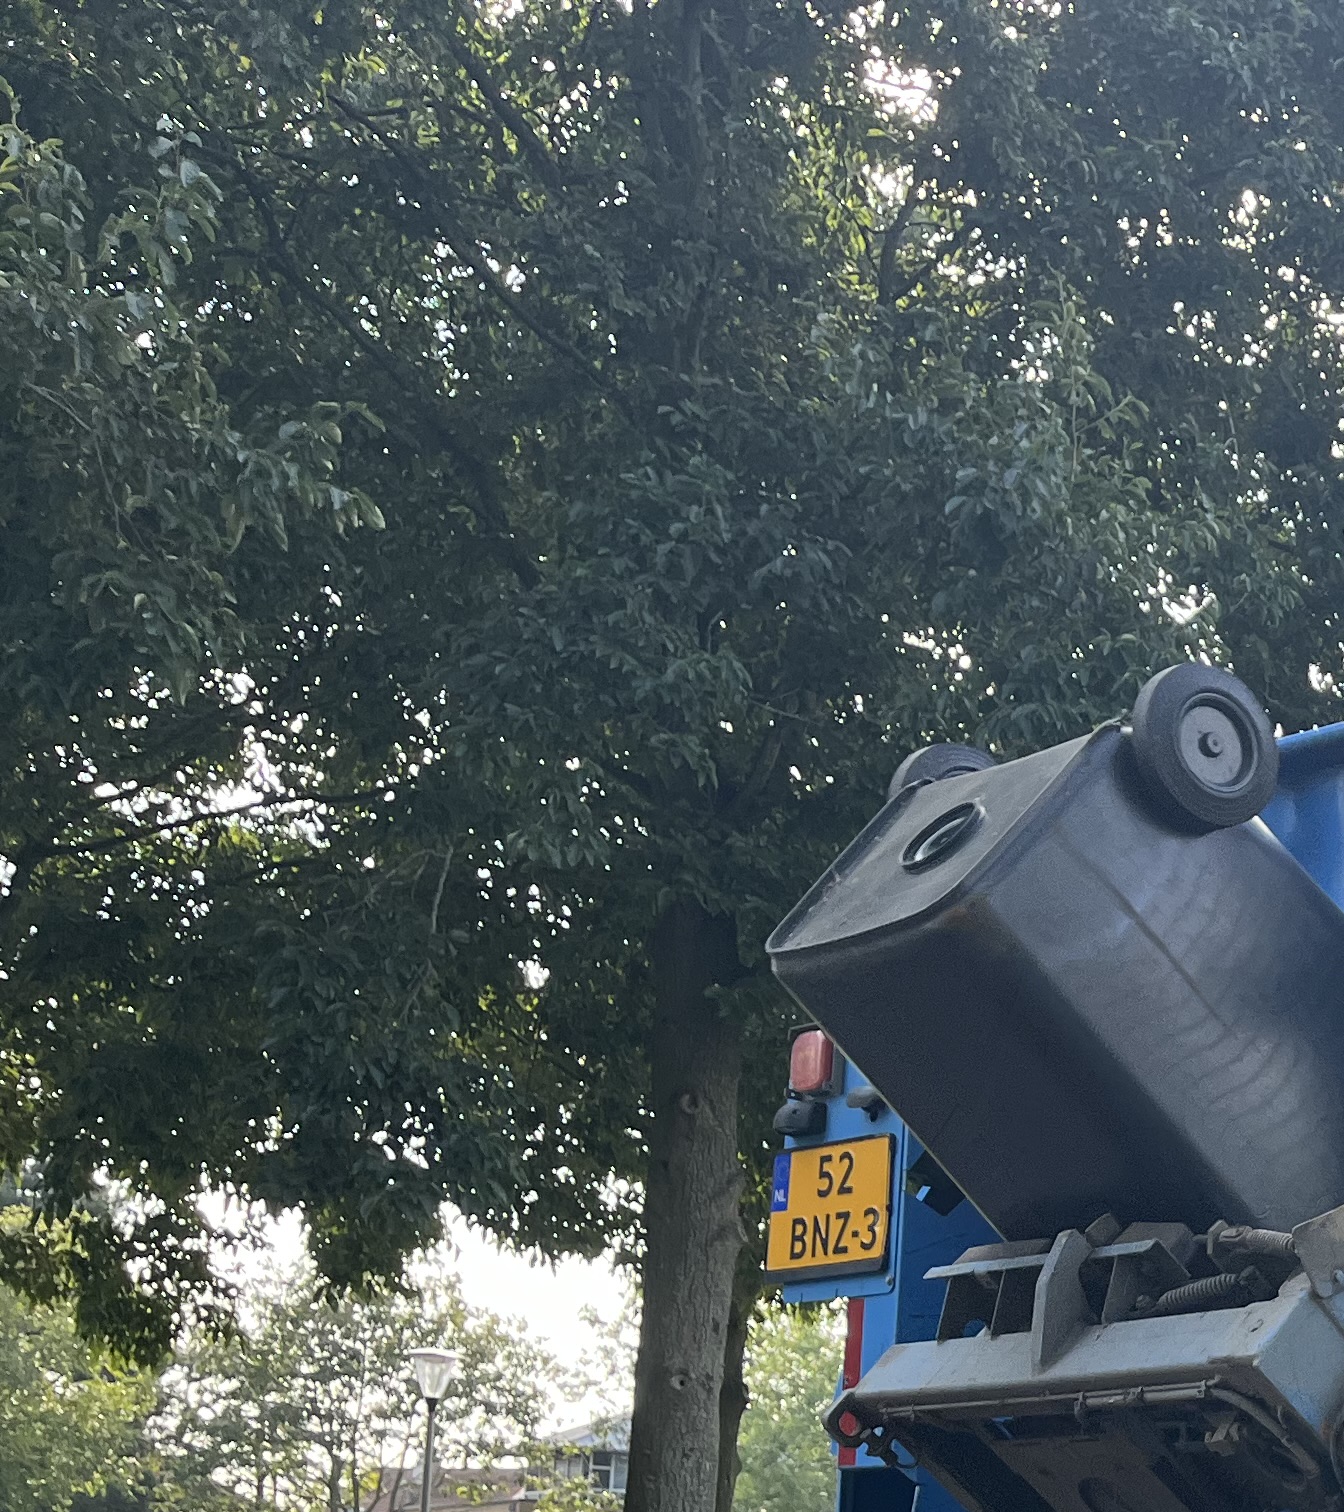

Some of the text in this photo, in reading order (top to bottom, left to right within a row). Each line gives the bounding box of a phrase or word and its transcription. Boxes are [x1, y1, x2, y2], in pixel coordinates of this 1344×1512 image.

[773, 1189, 787, 1202] NL
[816, 1151, 855, 1198] 52
[789, 1206, 881, 1261] BNZ-3
